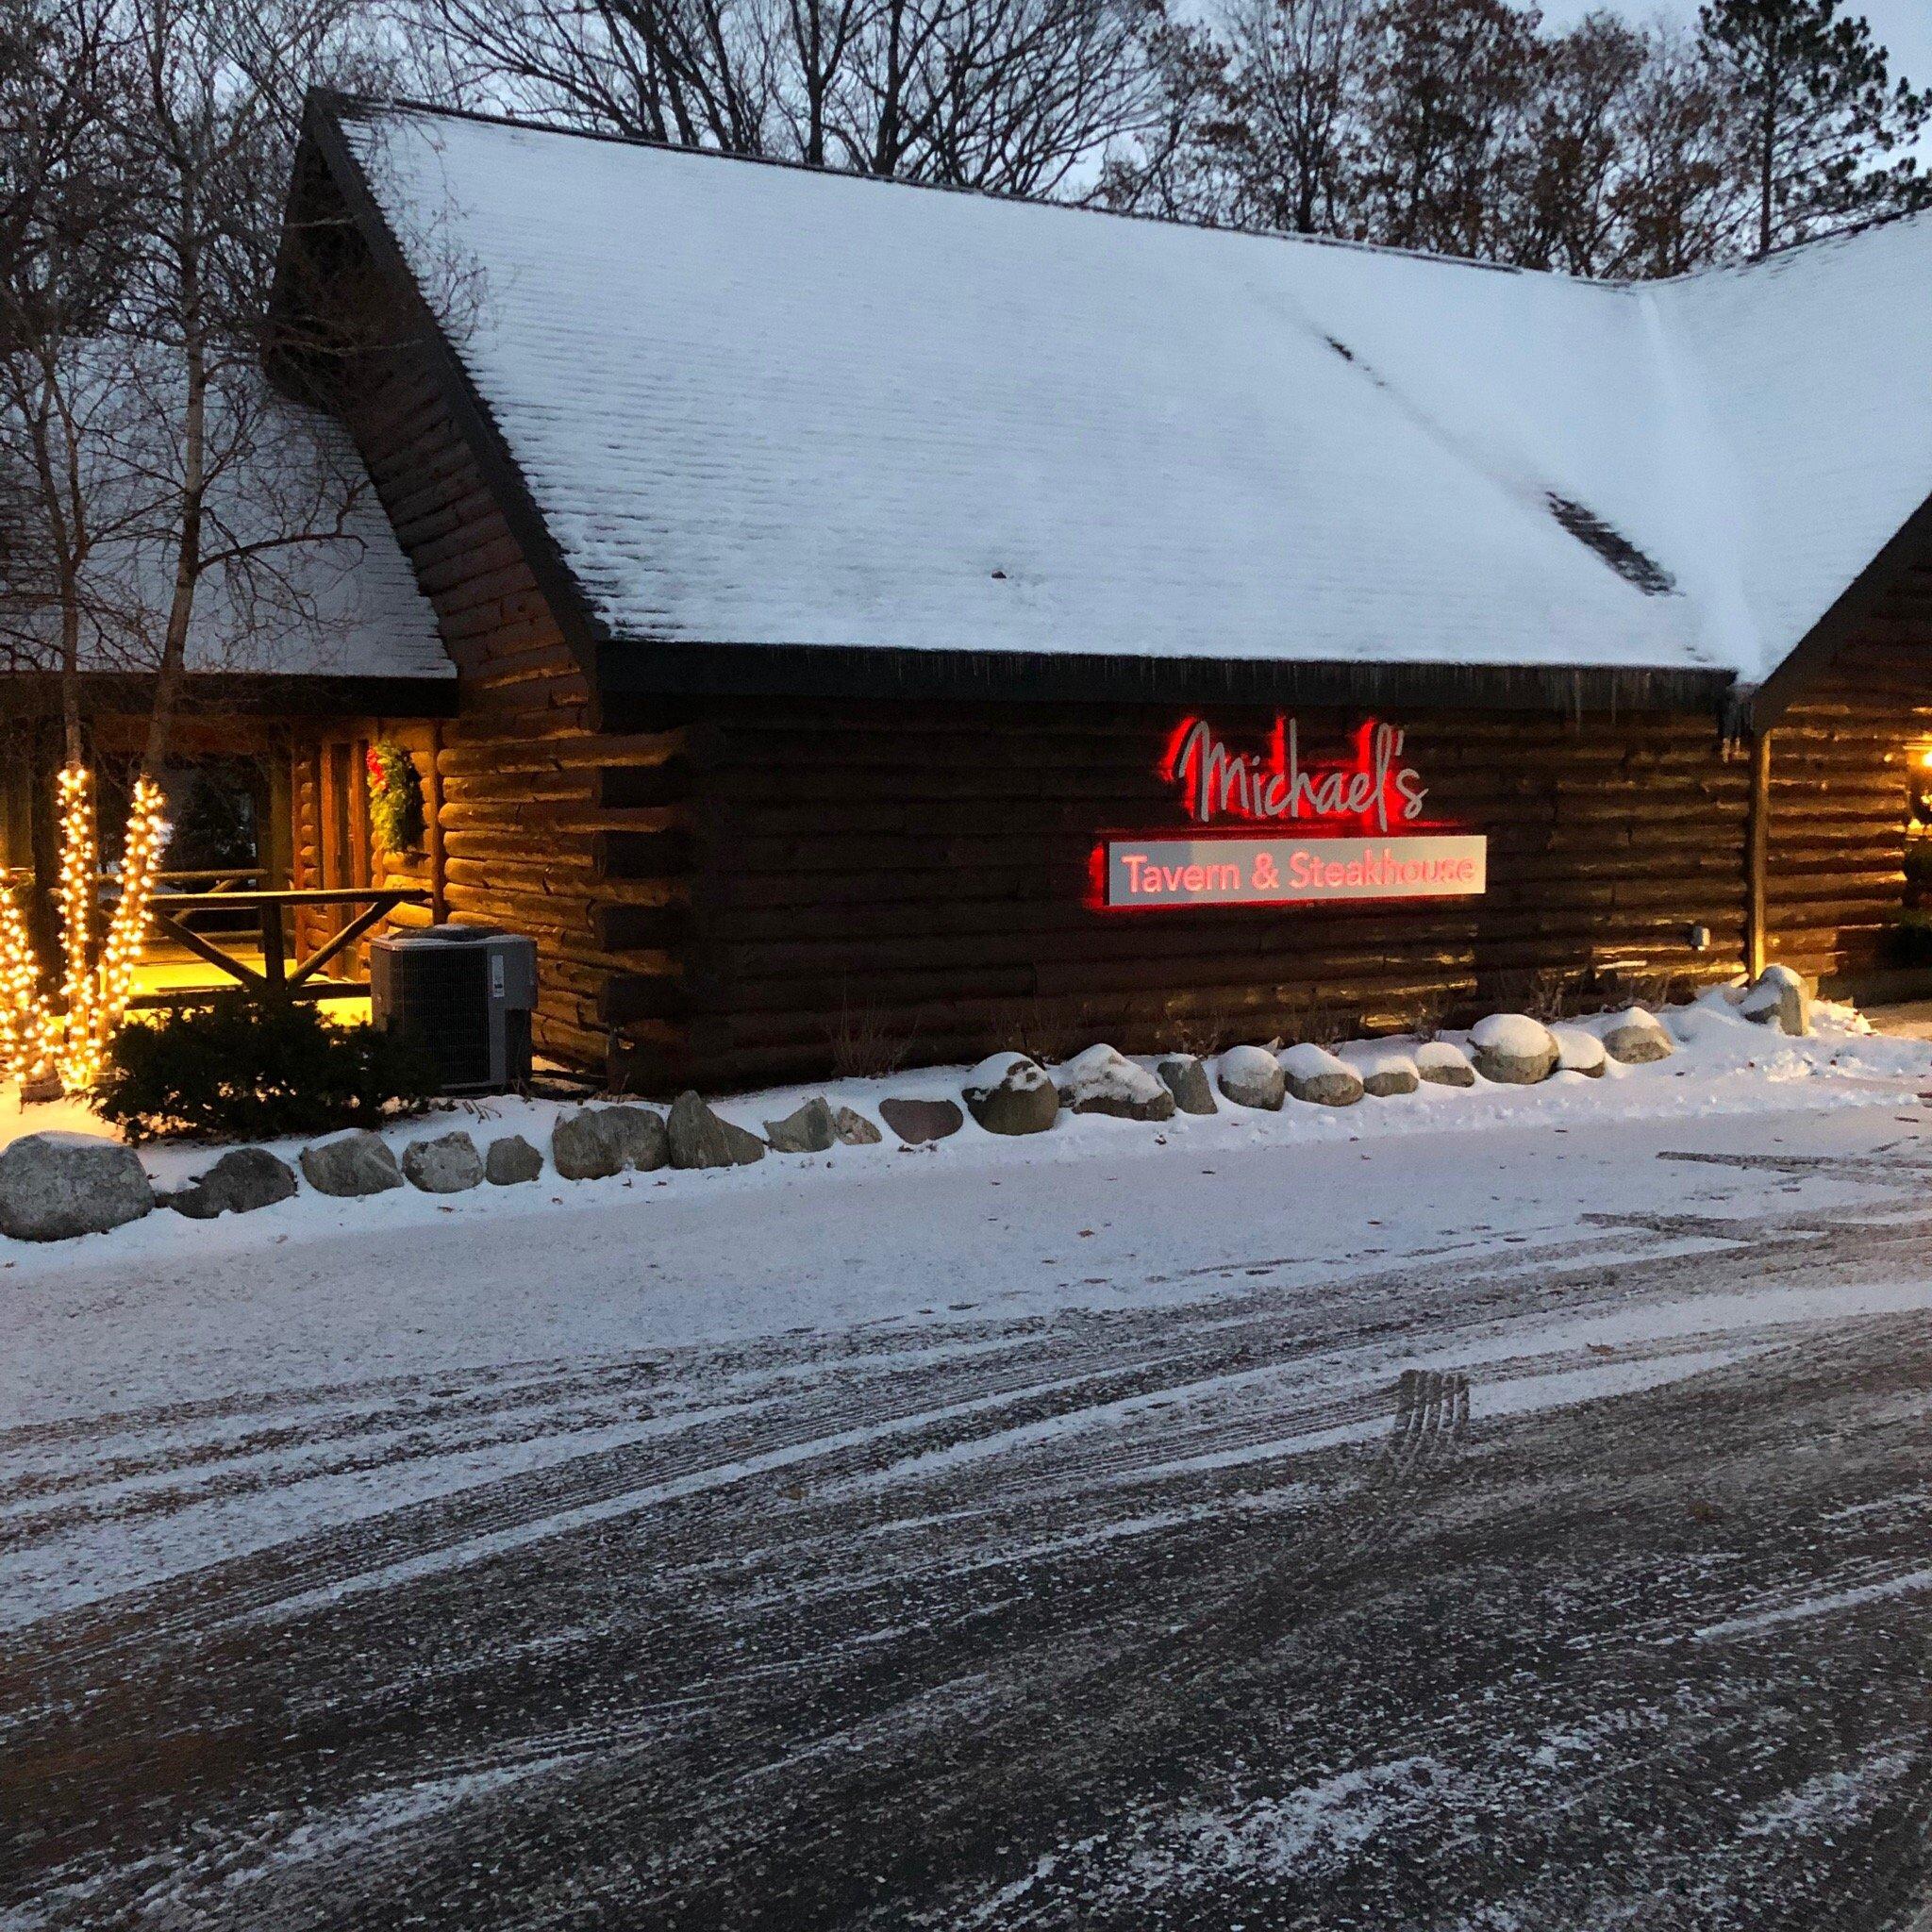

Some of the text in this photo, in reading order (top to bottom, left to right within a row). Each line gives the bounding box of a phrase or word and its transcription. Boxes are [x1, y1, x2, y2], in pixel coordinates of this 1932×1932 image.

[1178, 718, 1429, 832] Michael's
[1121, 847, 1477, 892] Tavern & Steakhouse
